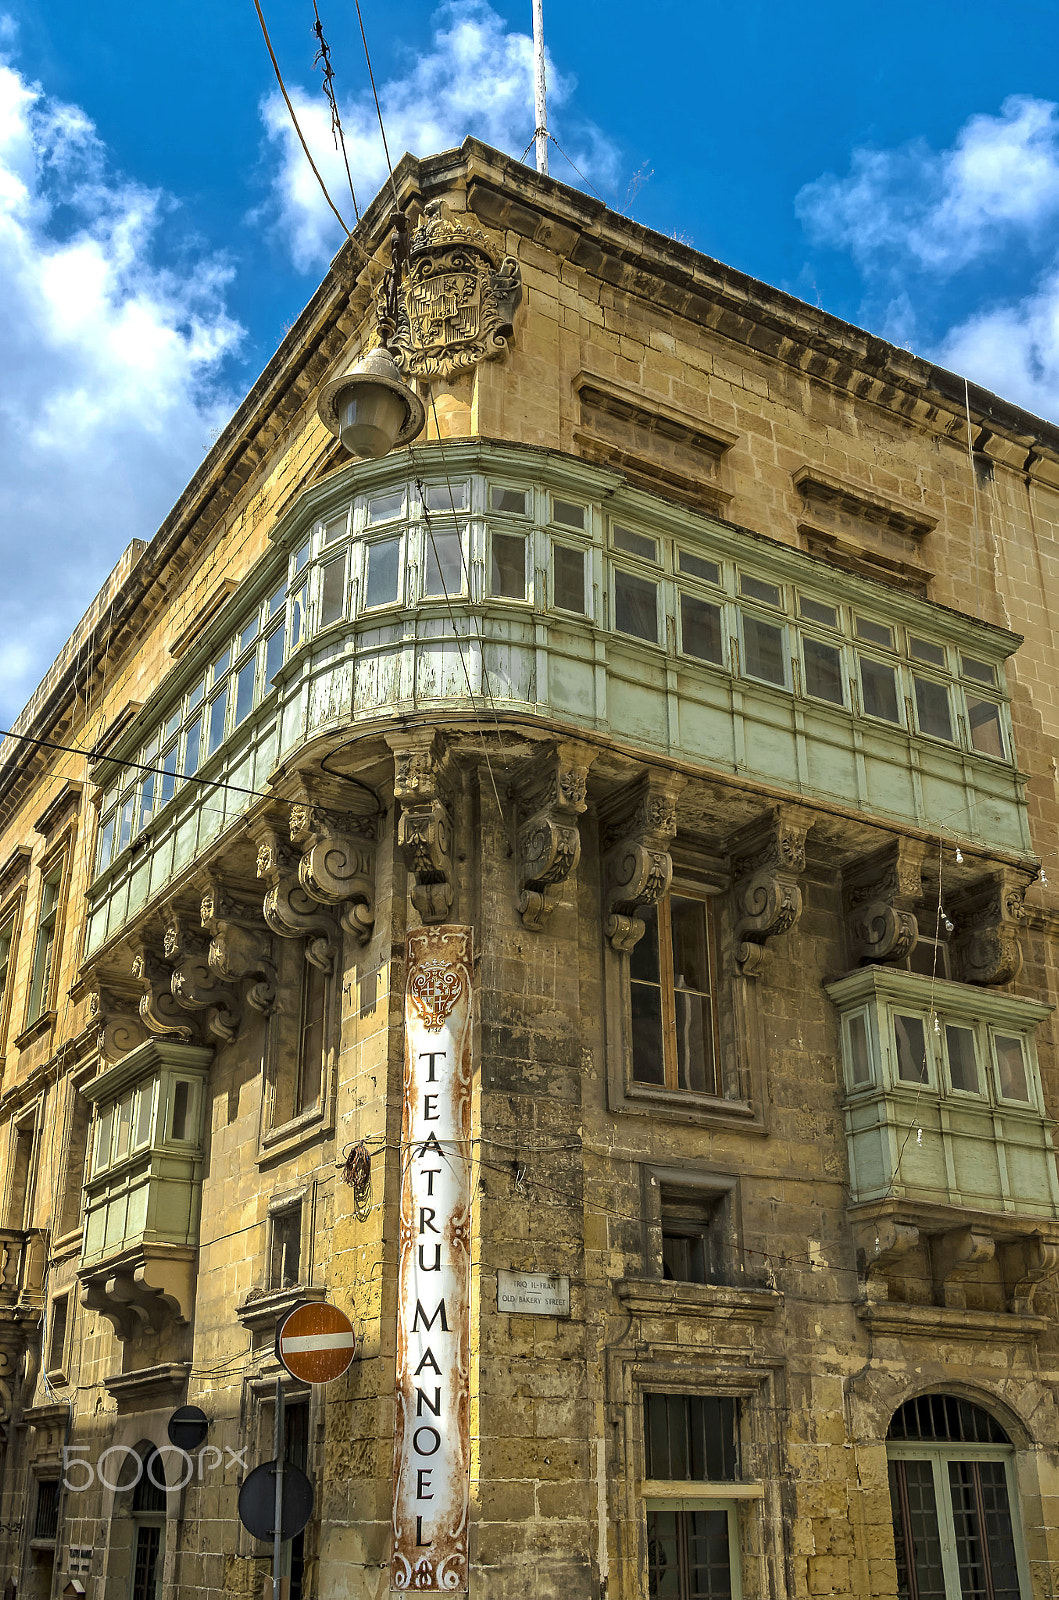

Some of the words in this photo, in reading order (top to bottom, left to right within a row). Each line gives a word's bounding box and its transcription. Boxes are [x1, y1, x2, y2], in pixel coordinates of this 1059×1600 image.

[418, 1051, 447, 1272] TEATRU
[518, 1296, 542, 1305] BAKERY
[545, 1298, 566, 1306] STREET
[531, 1281, 556, 1290] IL-FRAN
[410, 1297, 454, 1547] MANOEL
